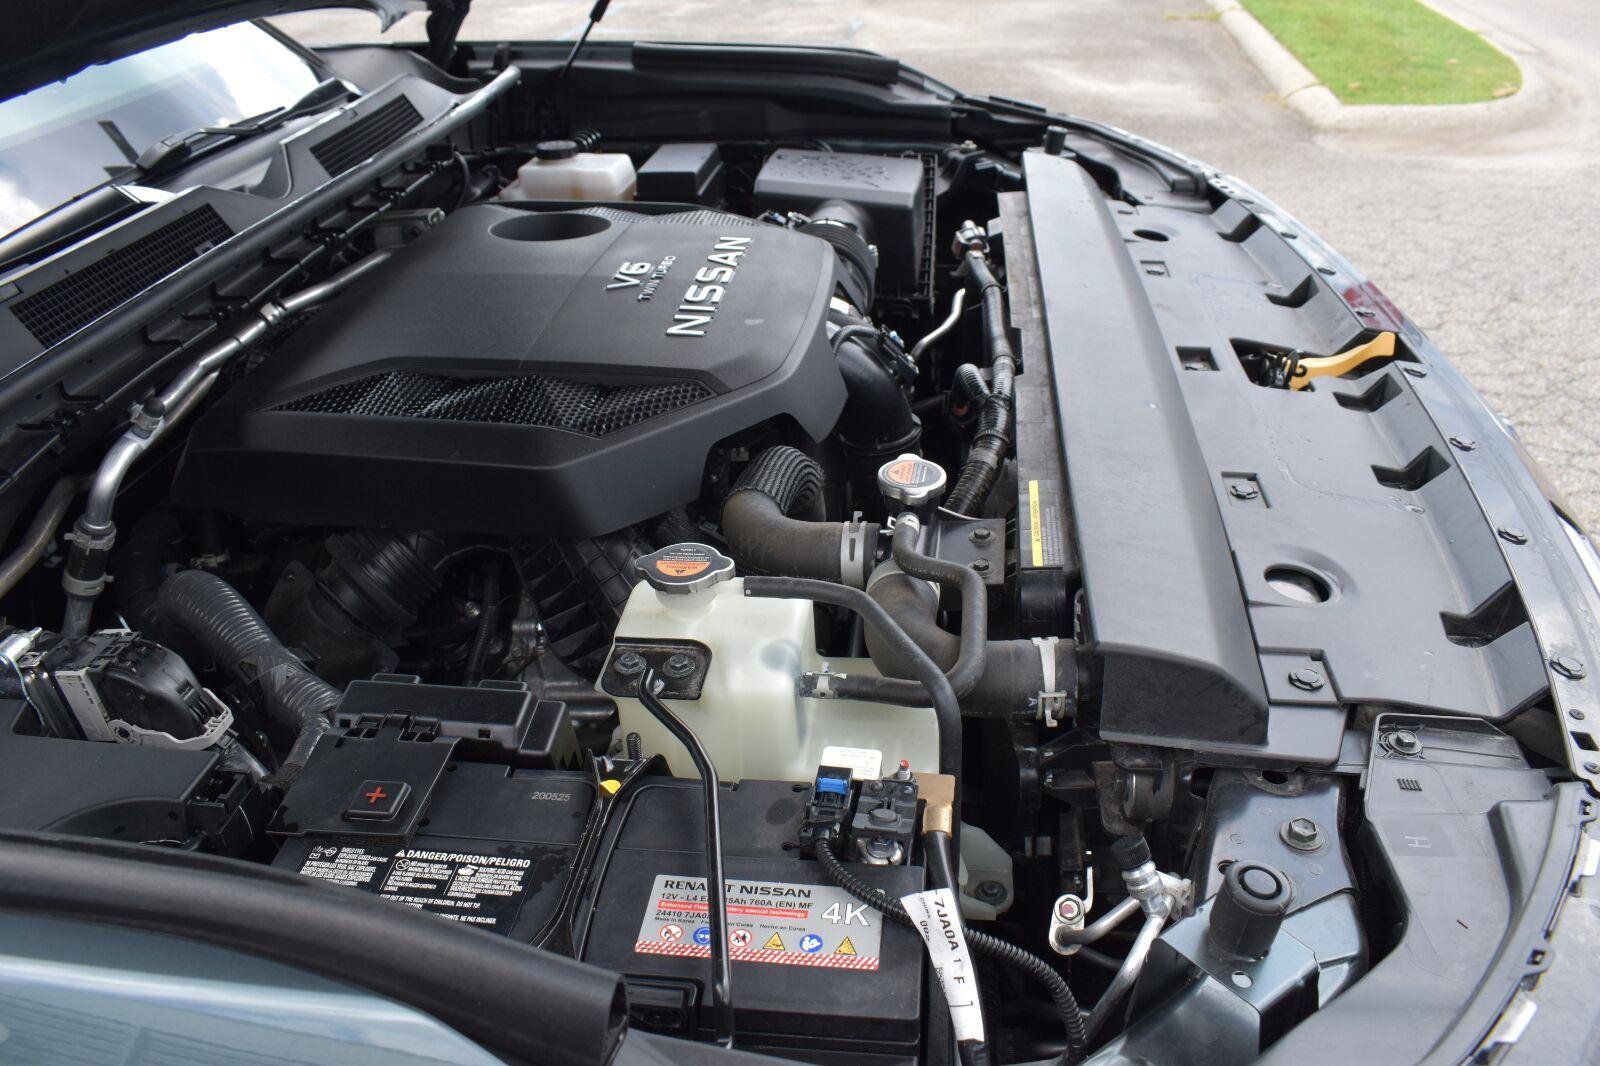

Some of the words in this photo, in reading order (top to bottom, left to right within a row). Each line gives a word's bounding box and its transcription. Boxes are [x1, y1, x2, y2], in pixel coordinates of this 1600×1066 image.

[606, 261, 653, 290] V6
[666, 236, 752, 337] NISSAN
[406, 850, 531, 868] DANGER/POISON/PELIGRO
[664, 880, 735, 893] RENAT
[739, 884, 812, 898] NISSAN
[661, 892, 679, 900] 12V
[686, 894, 698, 902] L4
[749, 898, 773, 906] 760A
[775, 900, 796, 909] (EN)
[656, 910, 682, 918] 24410
[660, 902, 693, 910] Enhanced
[745, 908, 768, 916] special
[769, 909, 806, 918] technology
[821, 902, 870, 927] 4K
